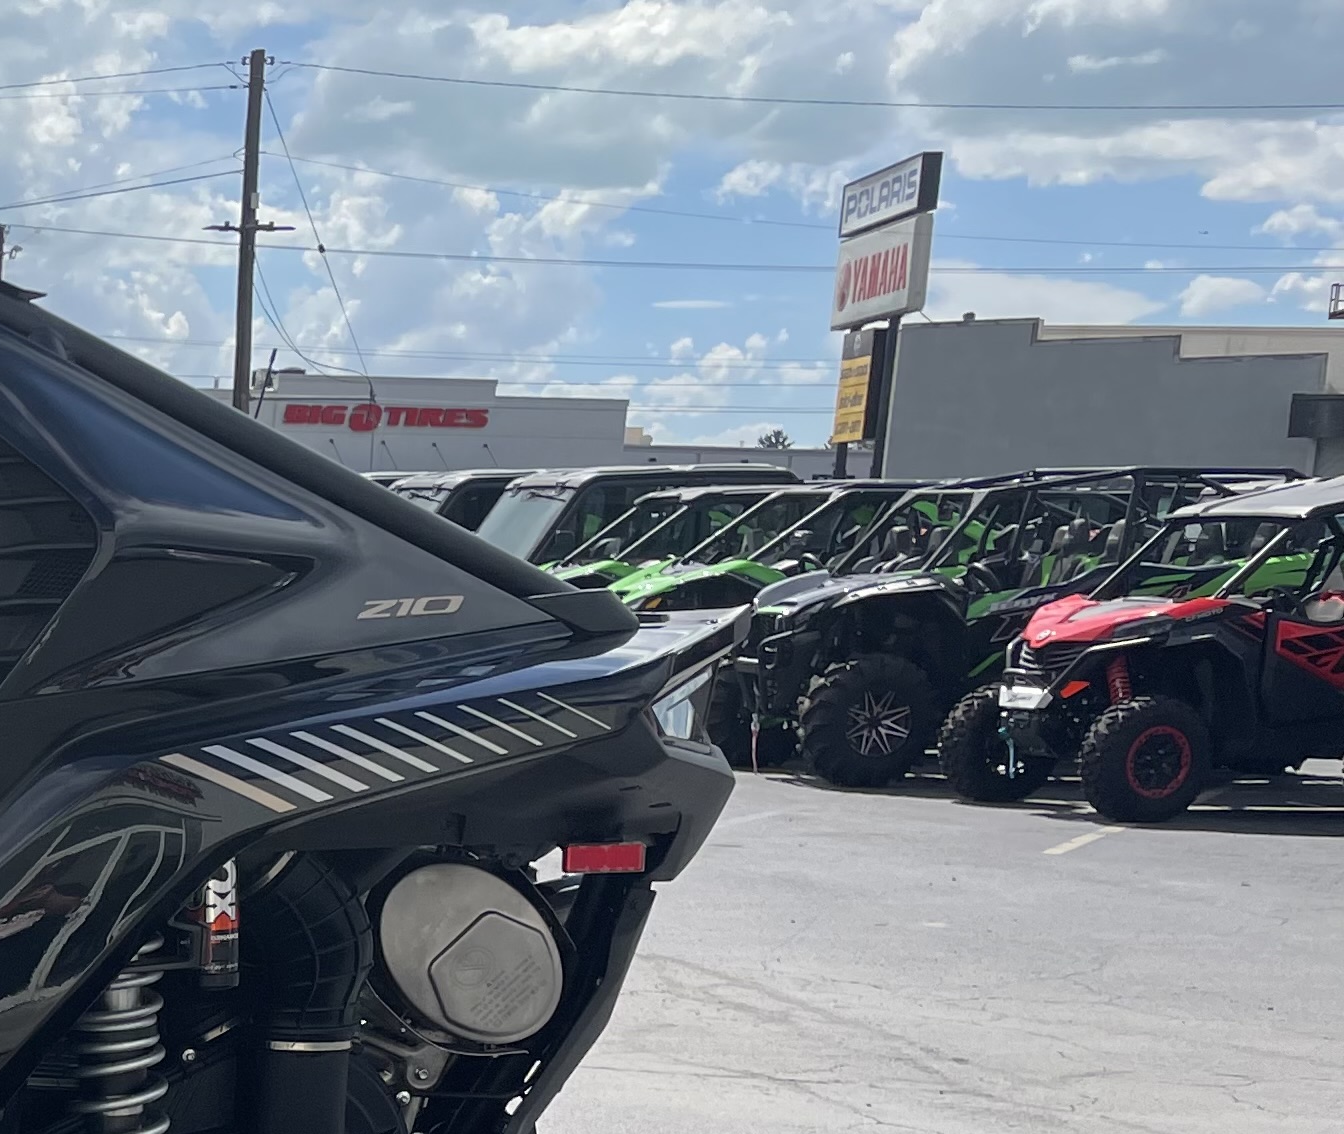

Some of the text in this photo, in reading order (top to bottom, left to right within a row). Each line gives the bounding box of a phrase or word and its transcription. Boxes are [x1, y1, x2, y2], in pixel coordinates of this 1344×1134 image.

[845, 168, 918, 224] POLARIS
[852, 242, 909, 304] YAMAHA
[283, 403, 490, 432] BIG O TIRES
[357, 595, 465, 620] Z10
[206, 857, 237, 923] OX
